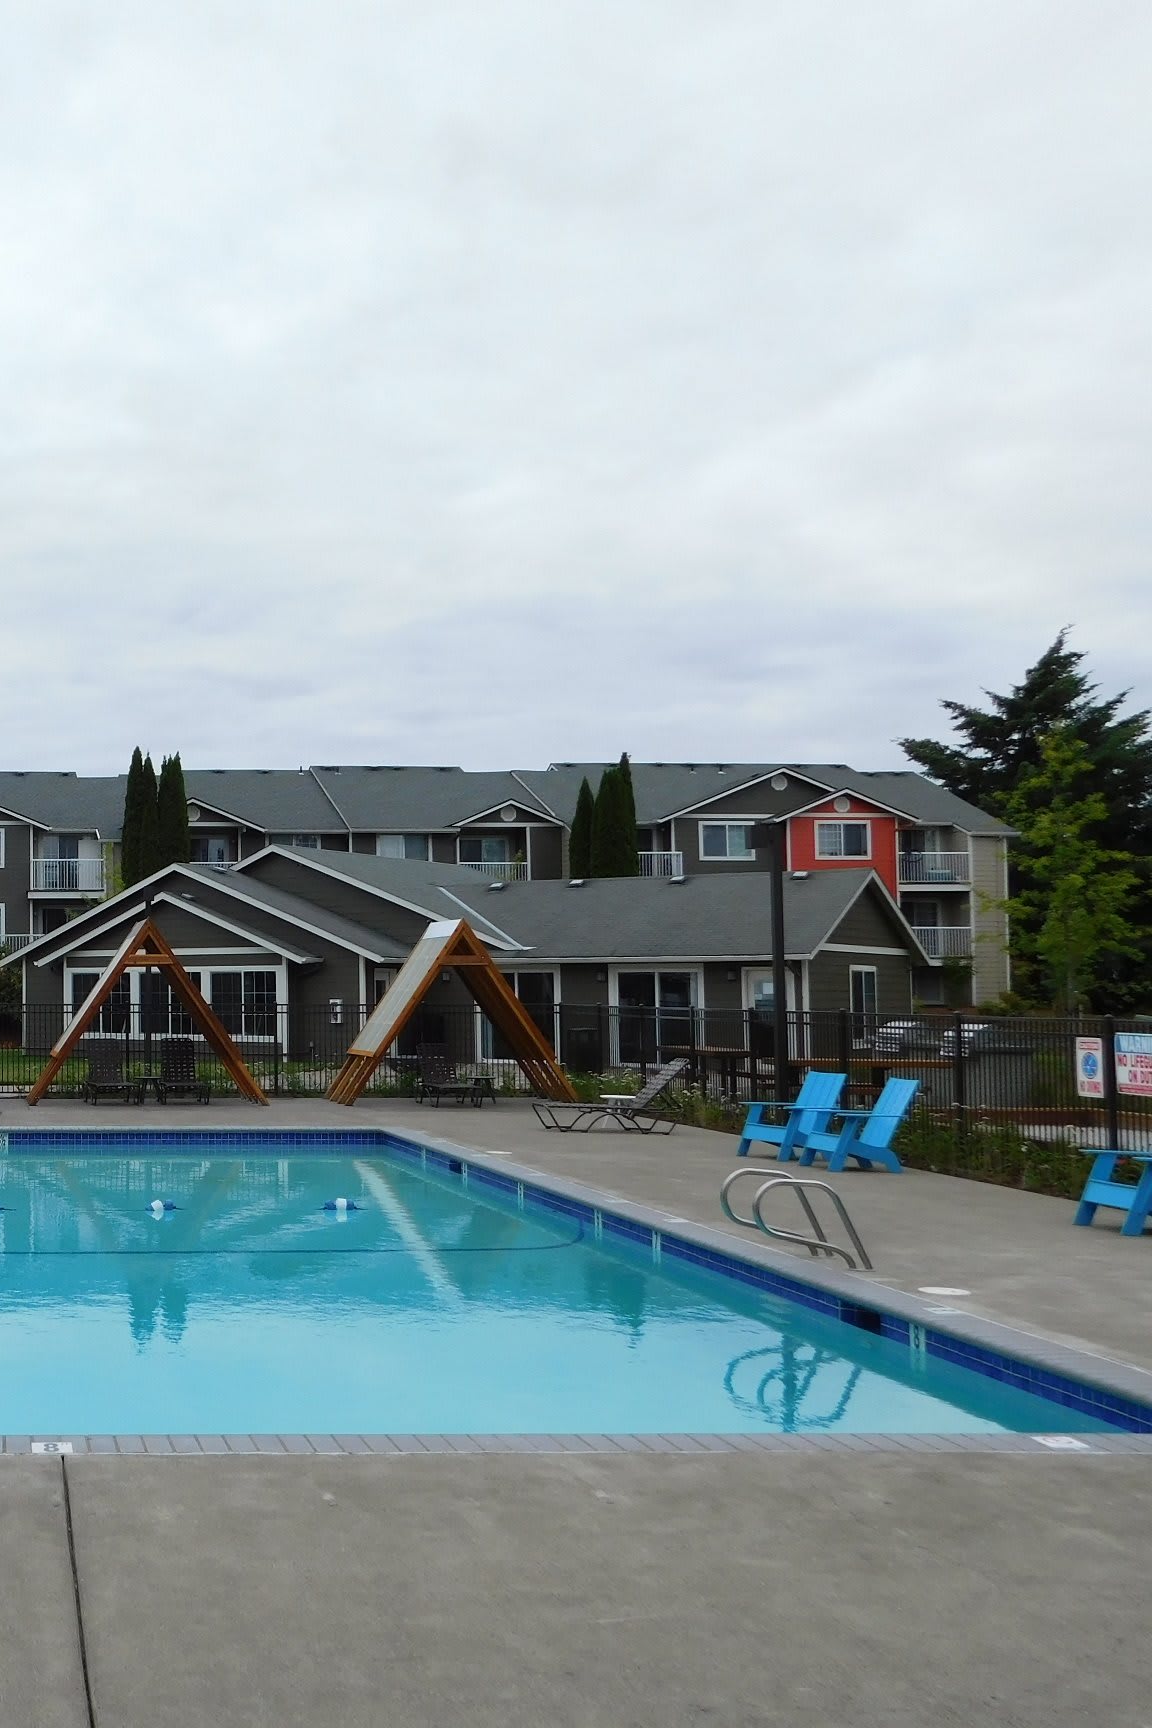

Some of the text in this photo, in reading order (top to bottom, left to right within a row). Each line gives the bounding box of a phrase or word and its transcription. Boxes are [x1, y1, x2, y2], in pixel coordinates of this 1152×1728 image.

[1117, 1054, 1127, 1067] NO
[1128, 1069, 1138, 1082] ON
[914, 1325, 920, 1349] 8
[43, 1443, 59, 1453] 8
